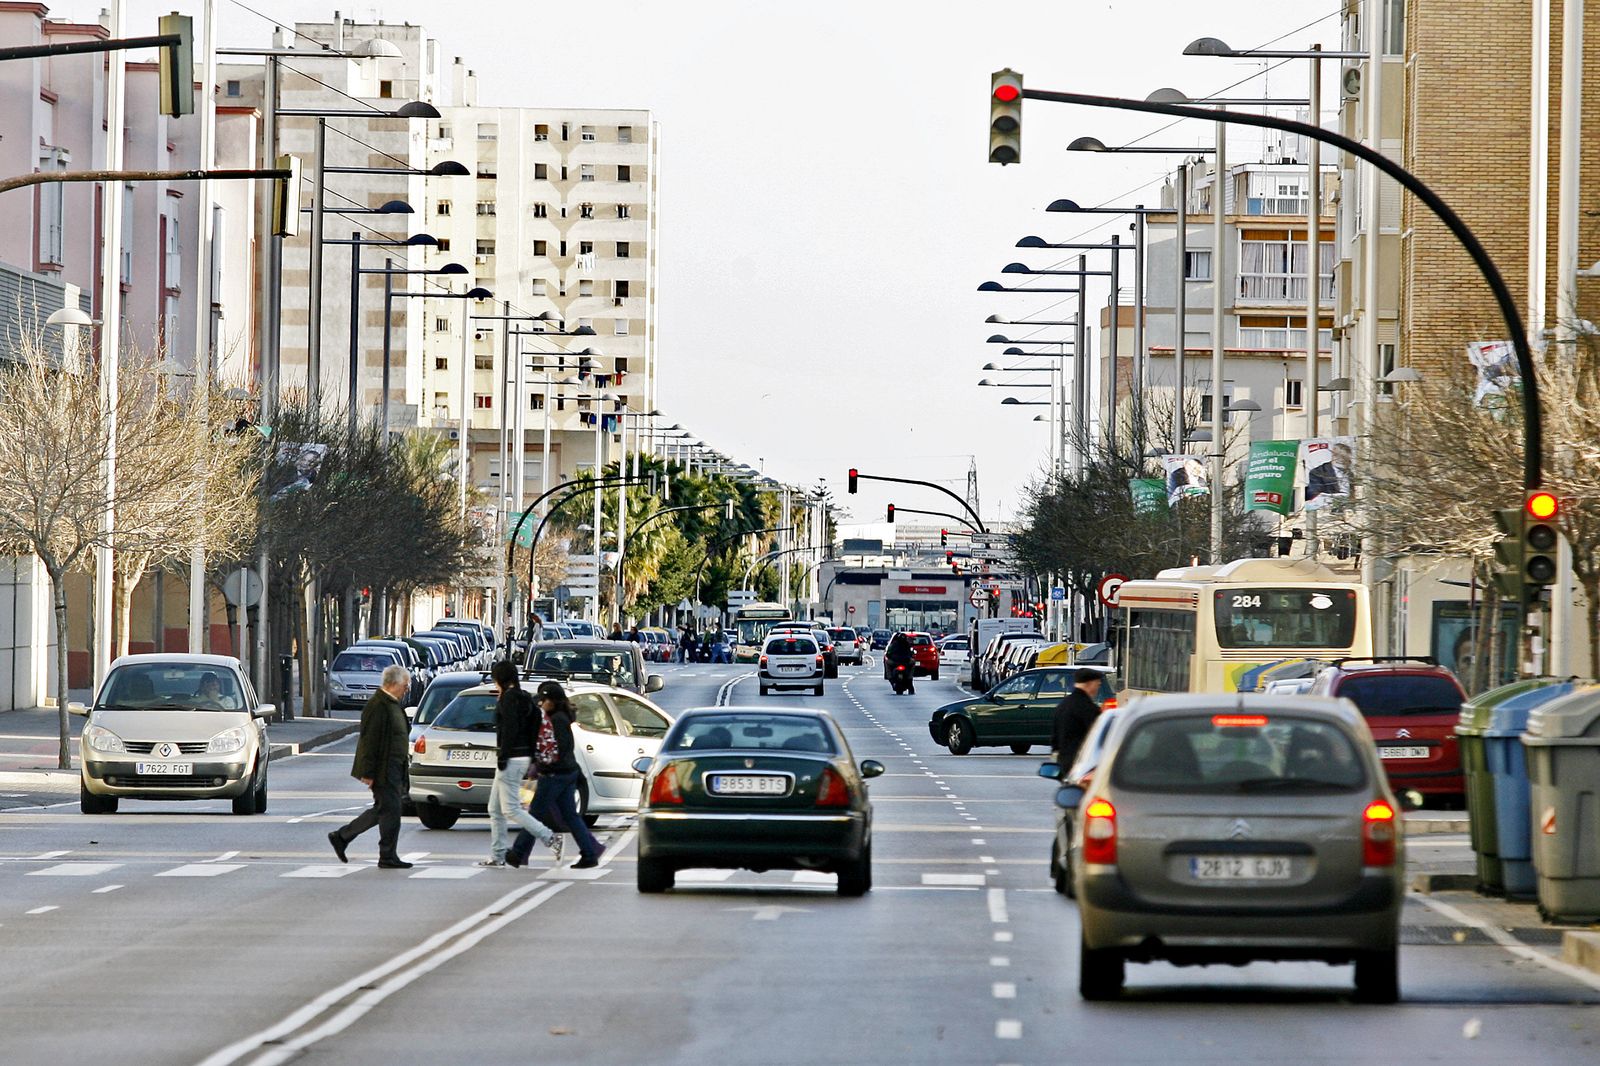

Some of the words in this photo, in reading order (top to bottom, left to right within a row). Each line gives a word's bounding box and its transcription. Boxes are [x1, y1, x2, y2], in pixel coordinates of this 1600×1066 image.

[1249, 458, 1267, 467] por
[1248, 464, 1286, 473] camino
[1248, 472, 1282, 480] seguro
[1232, 595, 1261, 608] 284
[1280, 595, 1289, 607] 5
[451, 750, 470, 760] 6588
[145, 764, 167, 774] 7622
[172, 764, 189, 774] FGT
[759, 778, 784, 790] BTS
